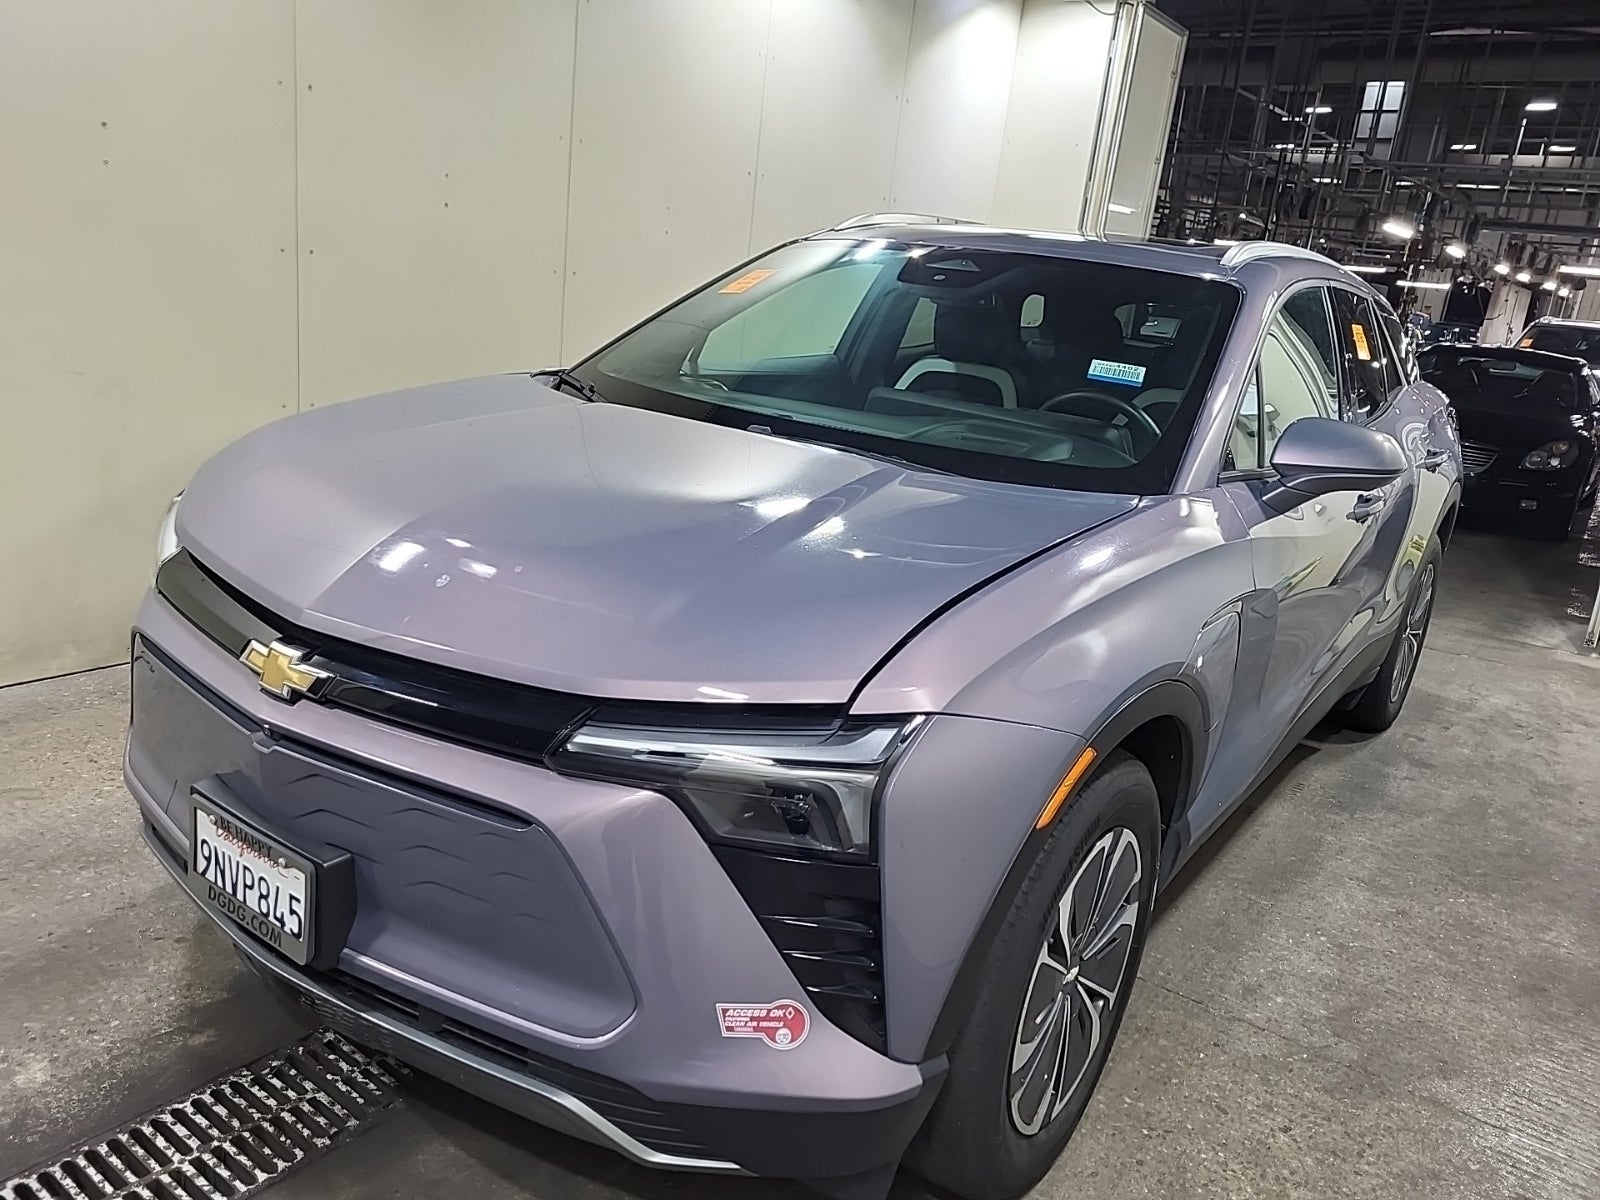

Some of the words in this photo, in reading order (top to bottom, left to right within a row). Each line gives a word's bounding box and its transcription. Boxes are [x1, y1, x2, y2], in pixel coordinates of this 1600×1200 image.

[220, 816, 232, 833] BE
[236, 826, 272, 858] HAPPY
[200, 838, 303, 941] 9NVP845
[207, 884, 282, 947] DGDG.COM
[725, 1009, 767, 1017] ACCESS
[769, 1009, 786, 1017] OK
